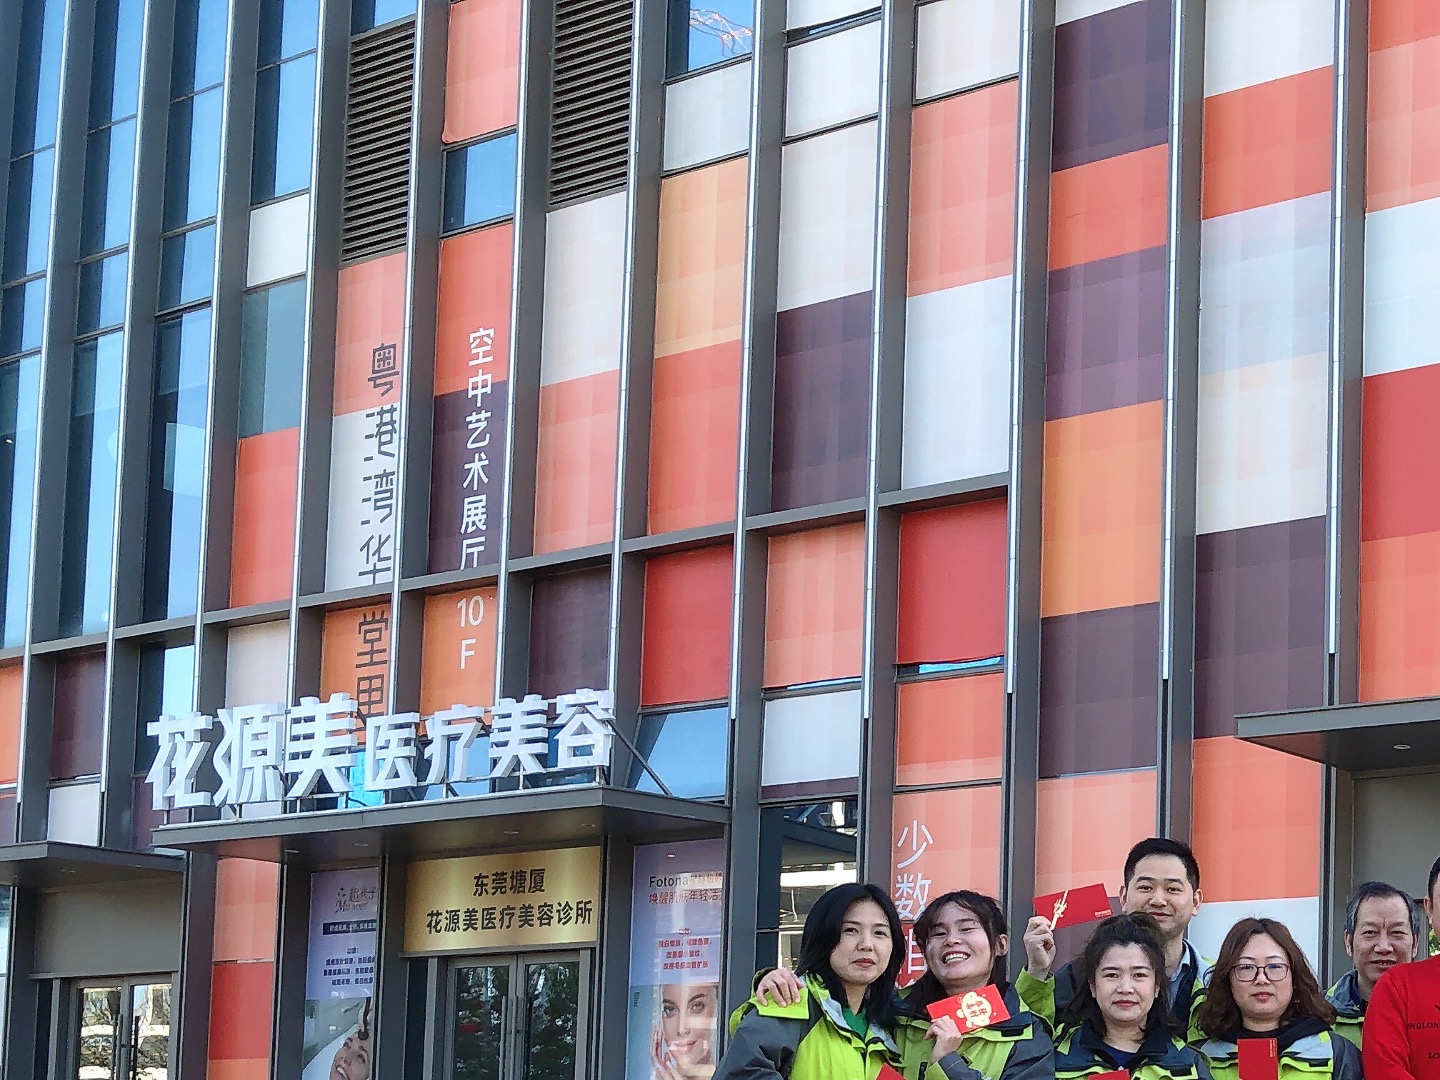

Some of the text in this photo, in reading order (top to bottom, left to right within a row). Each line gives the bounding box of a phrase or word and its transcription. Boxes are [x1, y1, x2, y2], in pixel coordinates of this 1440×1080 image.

[460, 327, 495, 571] 空中艺术展厅
[147, 688, 616, 811] 花源美医疗美容
[473, 868, 546, 897] 东莞塘厦
[649, 887, 723, 904] 唤醒肌肤年轻活
[427, 900, 592, 934] 花源美医疗美容诊所
